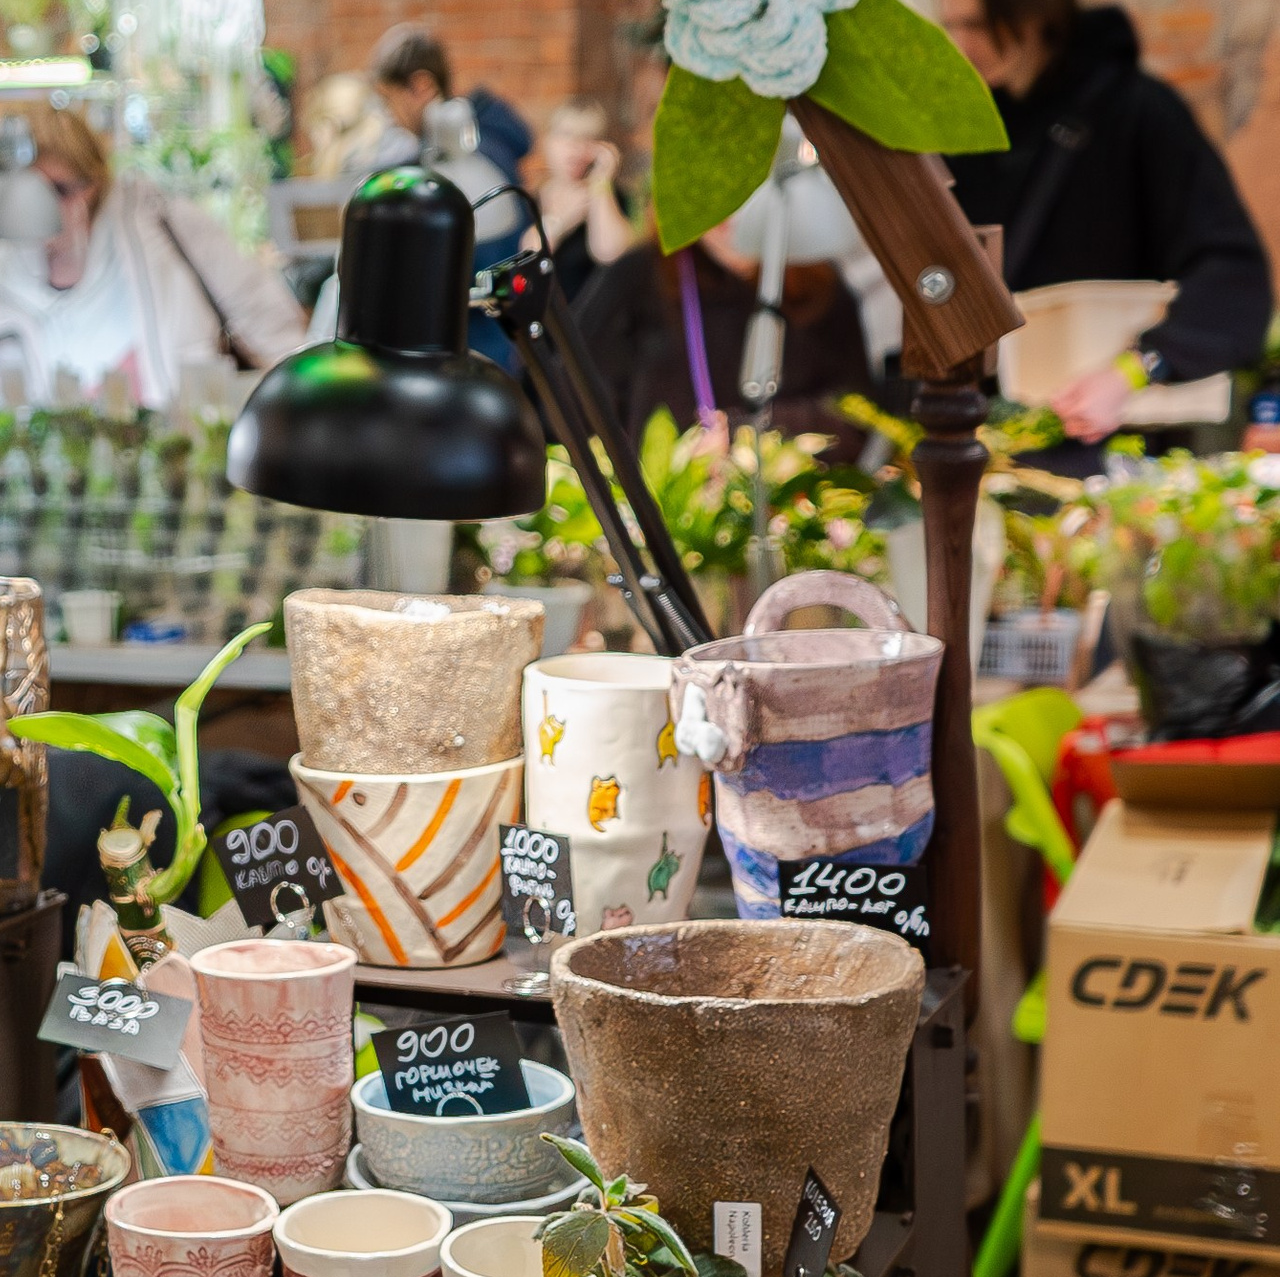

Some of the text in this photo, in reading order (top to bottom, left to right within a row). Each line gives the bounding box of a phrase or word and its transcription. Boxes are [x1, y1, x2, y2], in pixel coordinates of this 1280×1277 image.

[226, 819, 299, 865] 900
[500, 827, 559, 864] 1000
[788, 862, 906, 896] 1400
[1072, 956, 1266, 1021] CDEK
[396, 1023, 475, 1063] 900
[1062, 1162, 1138, 1216] XL
